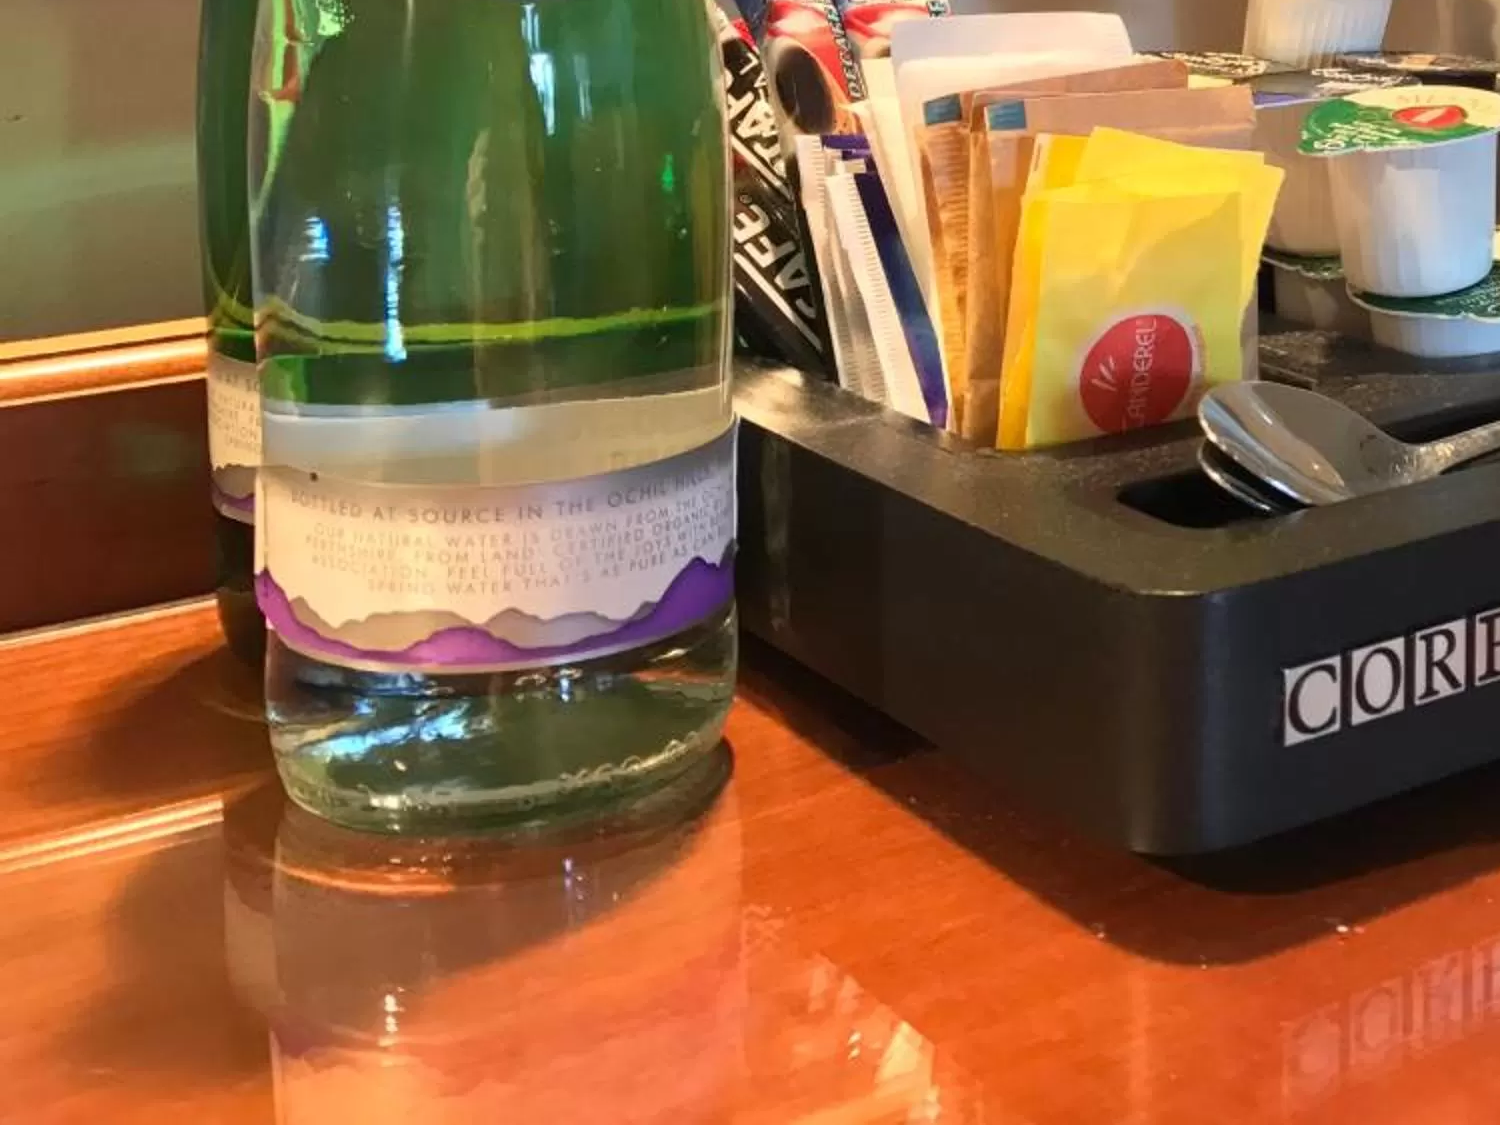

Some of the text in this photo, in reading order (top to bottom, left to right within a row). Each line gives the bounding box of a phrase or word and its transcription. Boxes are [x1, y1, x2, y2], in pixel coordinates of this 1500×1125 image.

[373, 506, 396, 522] AT
[408, 507, 505, 524] SOURCE
[518, 506, 543, 521] IN
[556, 499, 595, 516] THE
